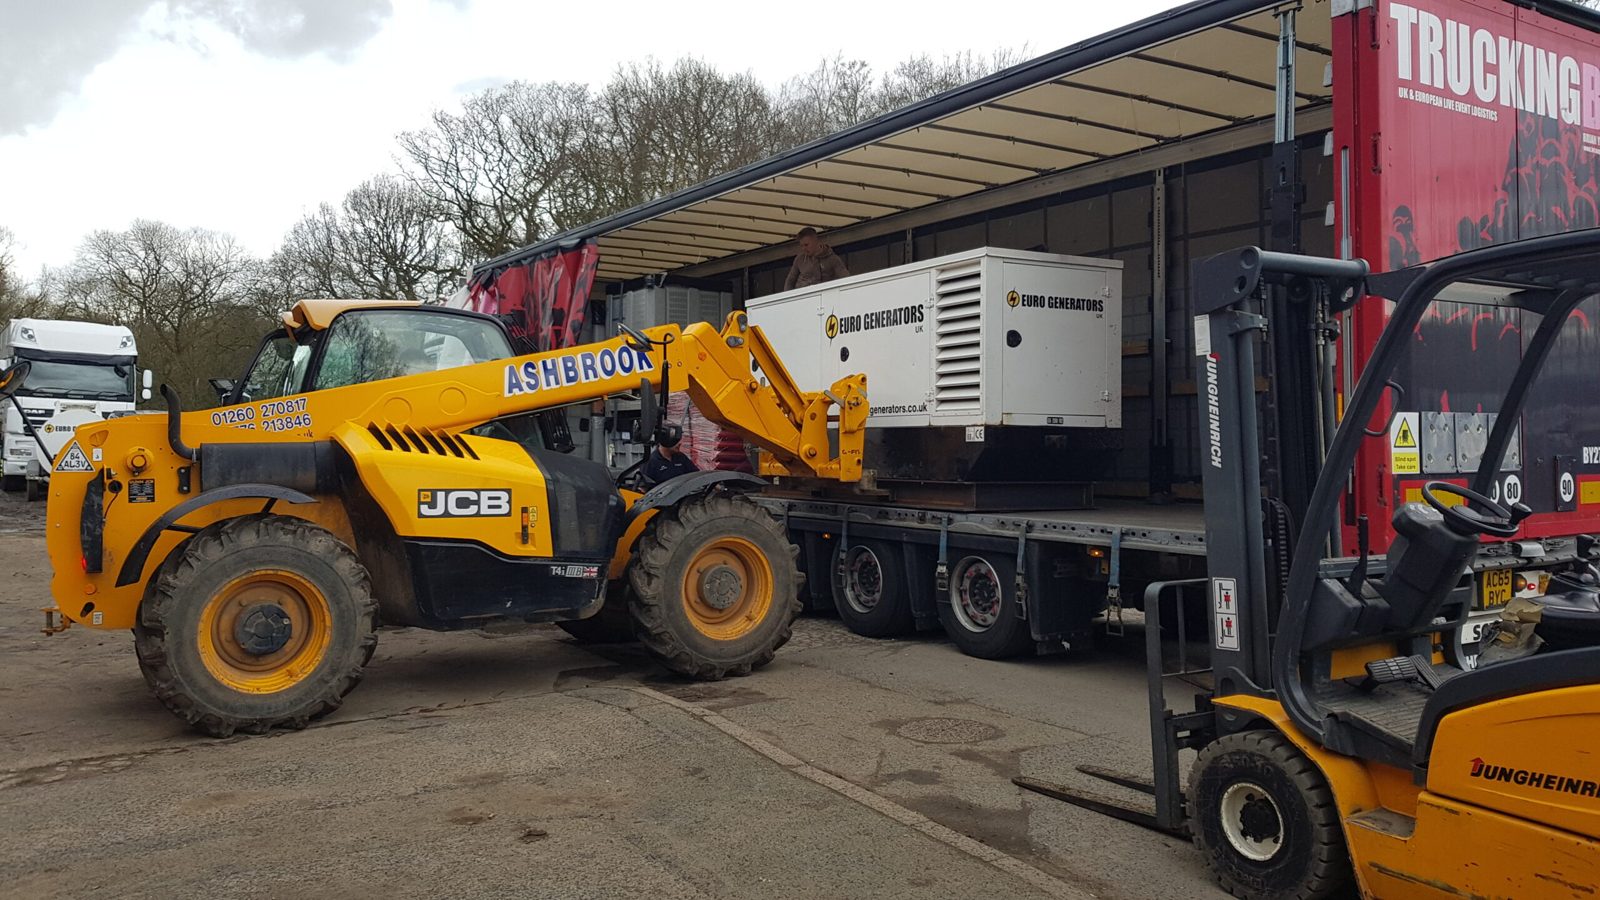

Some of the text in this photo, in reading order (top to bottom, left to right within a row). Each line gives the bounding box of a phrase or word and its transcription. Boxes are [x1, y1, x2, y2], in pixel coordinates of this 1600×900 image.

[1398, 86, 1498, 122] UK & EUROPEAN LIVE EVENT LOGISTICS
[1021, 294, 1104, 312] EURO GENERATORS
[840, 304, 924, 334] EURO GENERATORS
[915, 325, 924, 334] UK
[505, 345, 654, 397] ASHBROOK
[211, 397, 308, 426] 01260 270817
[1206, 353, 1222, 469] JUNGHEINRICH
[262, 413, 312, 432] 213846
[974, 429, 983, 439] CE
[70, 452, 80, 460] 84
[1506, 482, 1519, 500] 80
[1562, 479, 1573, 496] 90
[419, 490, 511, 517] JCB
[551, 566, 565, 576] T4i
[1486, 570, 1511, 589] AC65
[1488, 589, 1507, 606] BYC
